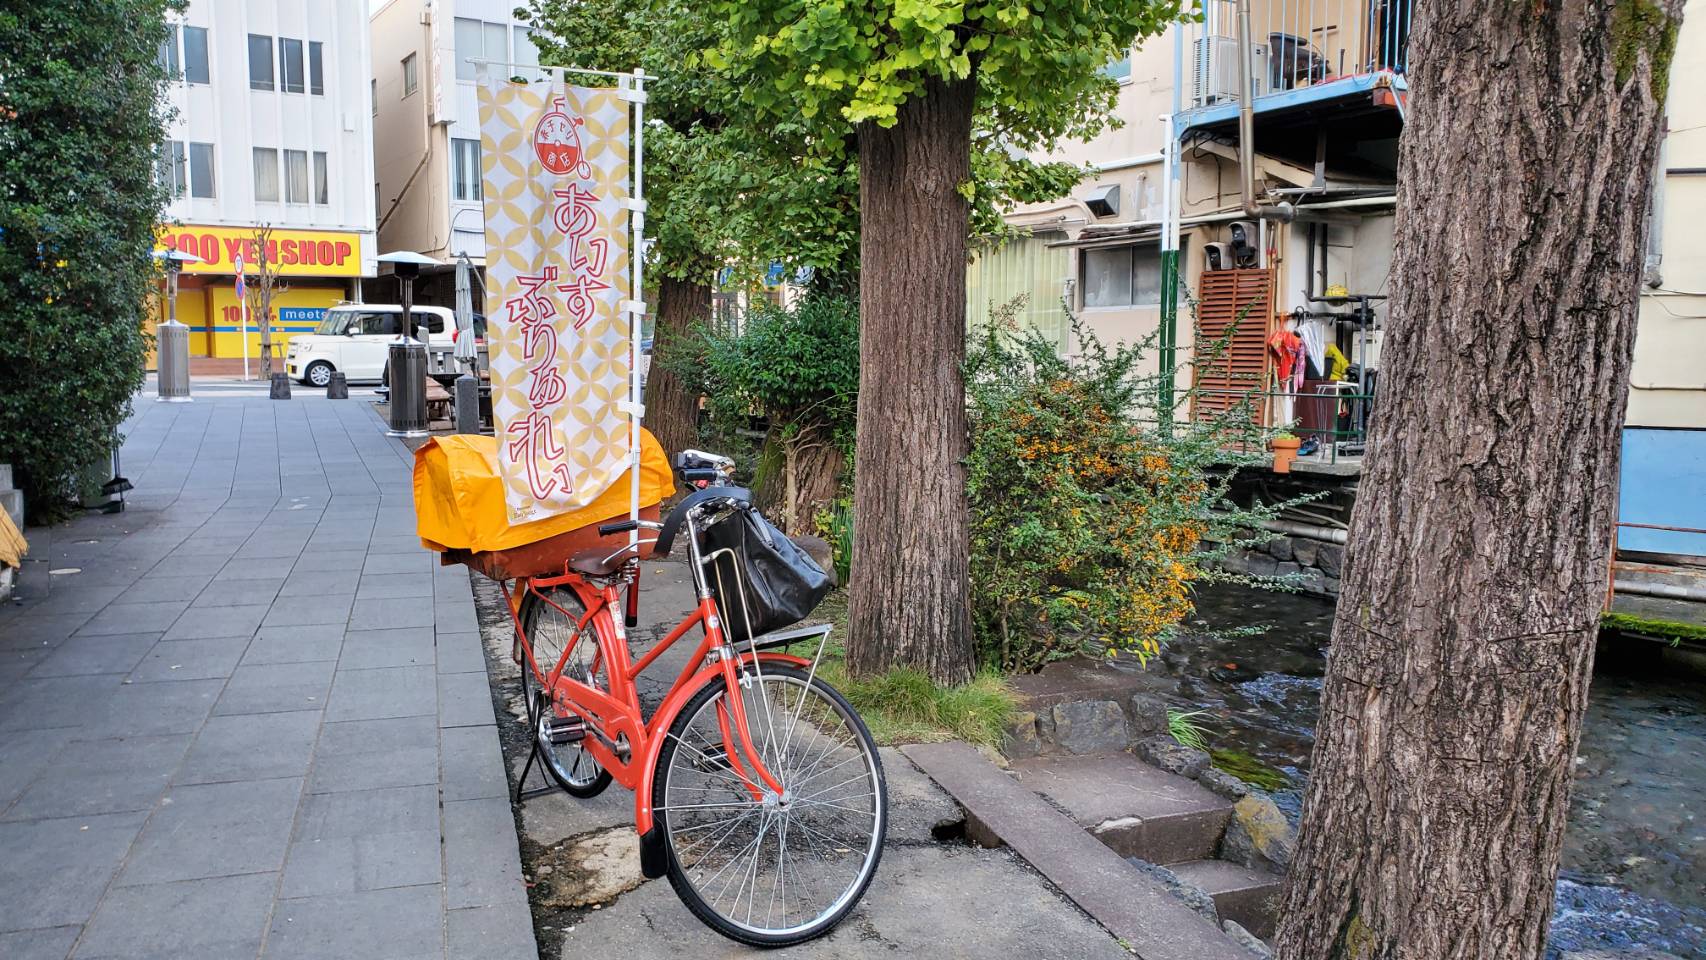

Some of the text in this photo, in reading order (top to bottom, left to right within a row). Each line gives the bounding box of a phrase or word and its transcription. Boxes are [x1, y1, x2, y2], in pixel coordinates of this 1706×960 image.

[163, 233, 220, 266] 100
[224, 238, 278, 265] YEN
[283, 239, 352, 267] SHOP
[553, 183, 612, 330] あいす
